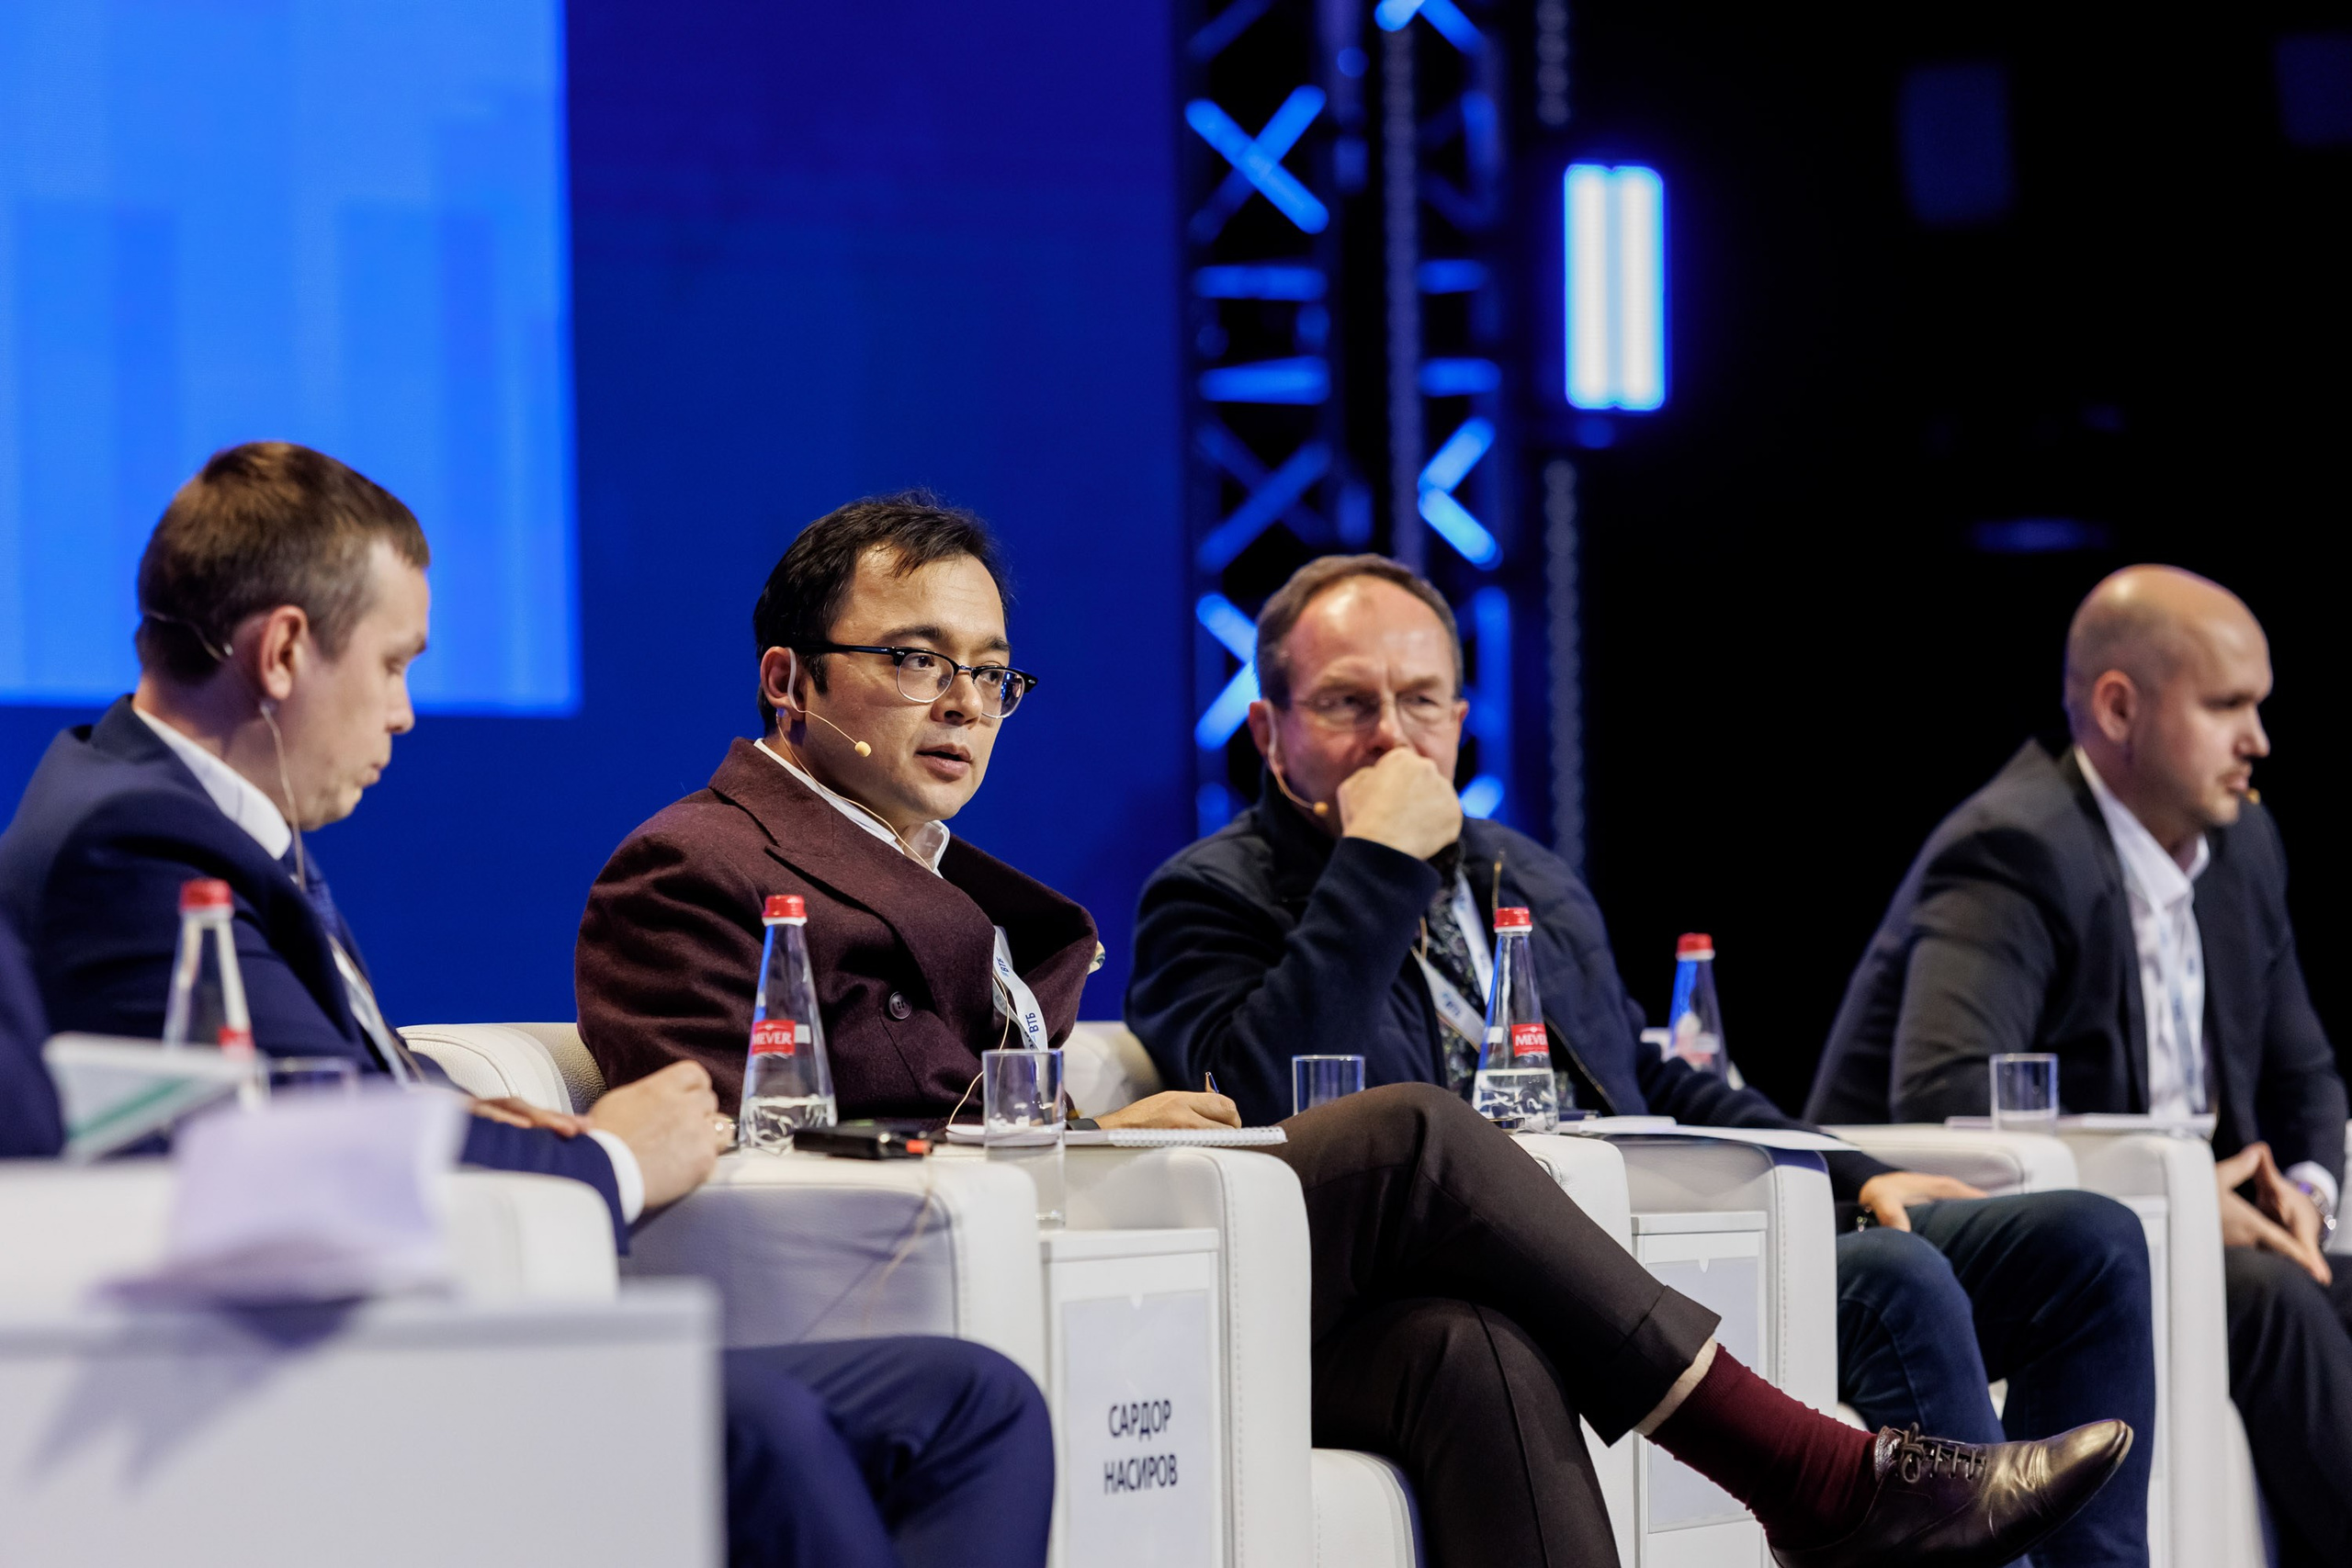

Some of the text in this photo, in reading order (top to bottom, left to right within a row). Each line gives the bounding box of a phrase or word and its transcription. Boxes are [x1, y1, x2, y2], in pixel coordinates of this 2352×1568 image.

[1025, 1012, 1039, 1034] ВТБ
[1108, 1399, 1171, 1442] САРДОР
[1103, 1454, 1177, 1495] НАСИРОВ
